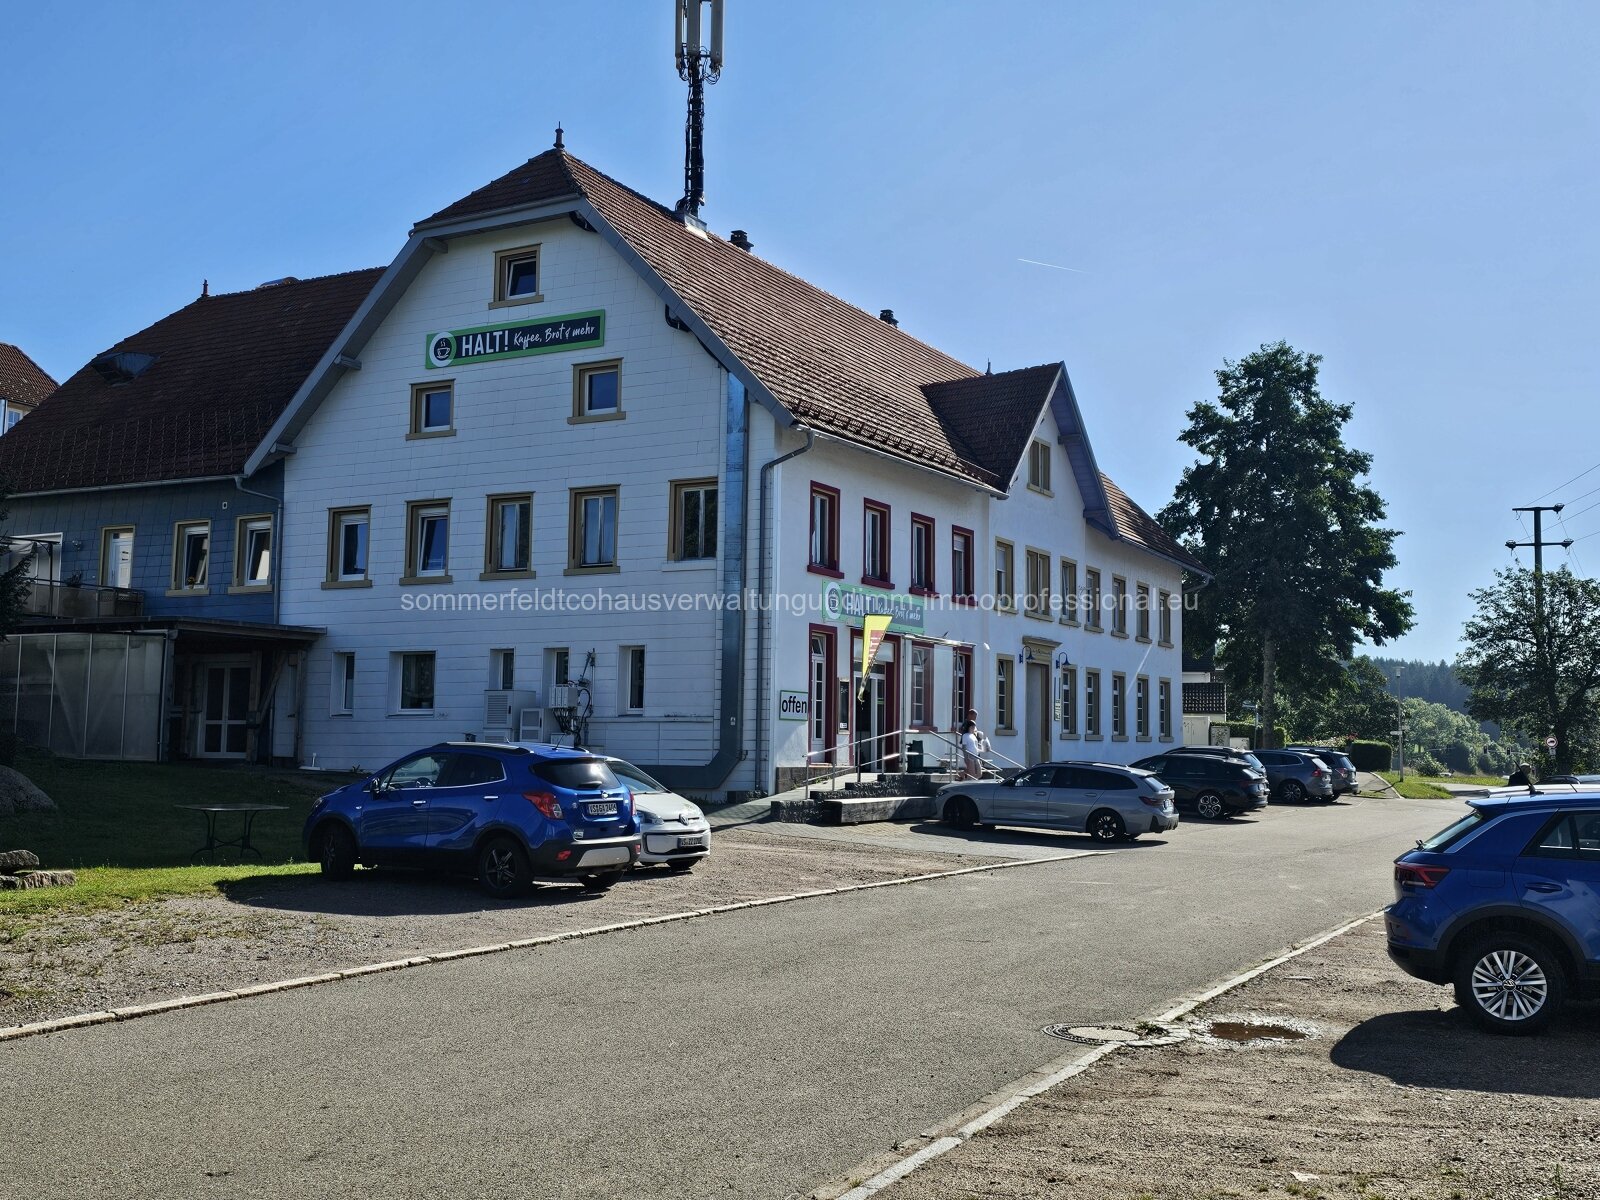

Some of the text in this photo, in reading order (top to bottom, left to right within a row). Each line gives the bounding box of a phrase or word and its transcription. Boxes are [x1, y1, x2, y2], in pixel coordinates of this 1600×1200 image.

[462, 330, 509, 357] HALT!
[513, 331, 543, 349] Kaffee,
[545, 323, 566, 342] Brot
[573, 322, 595, 336] mehr
[781, 696, 808, 713] offen
